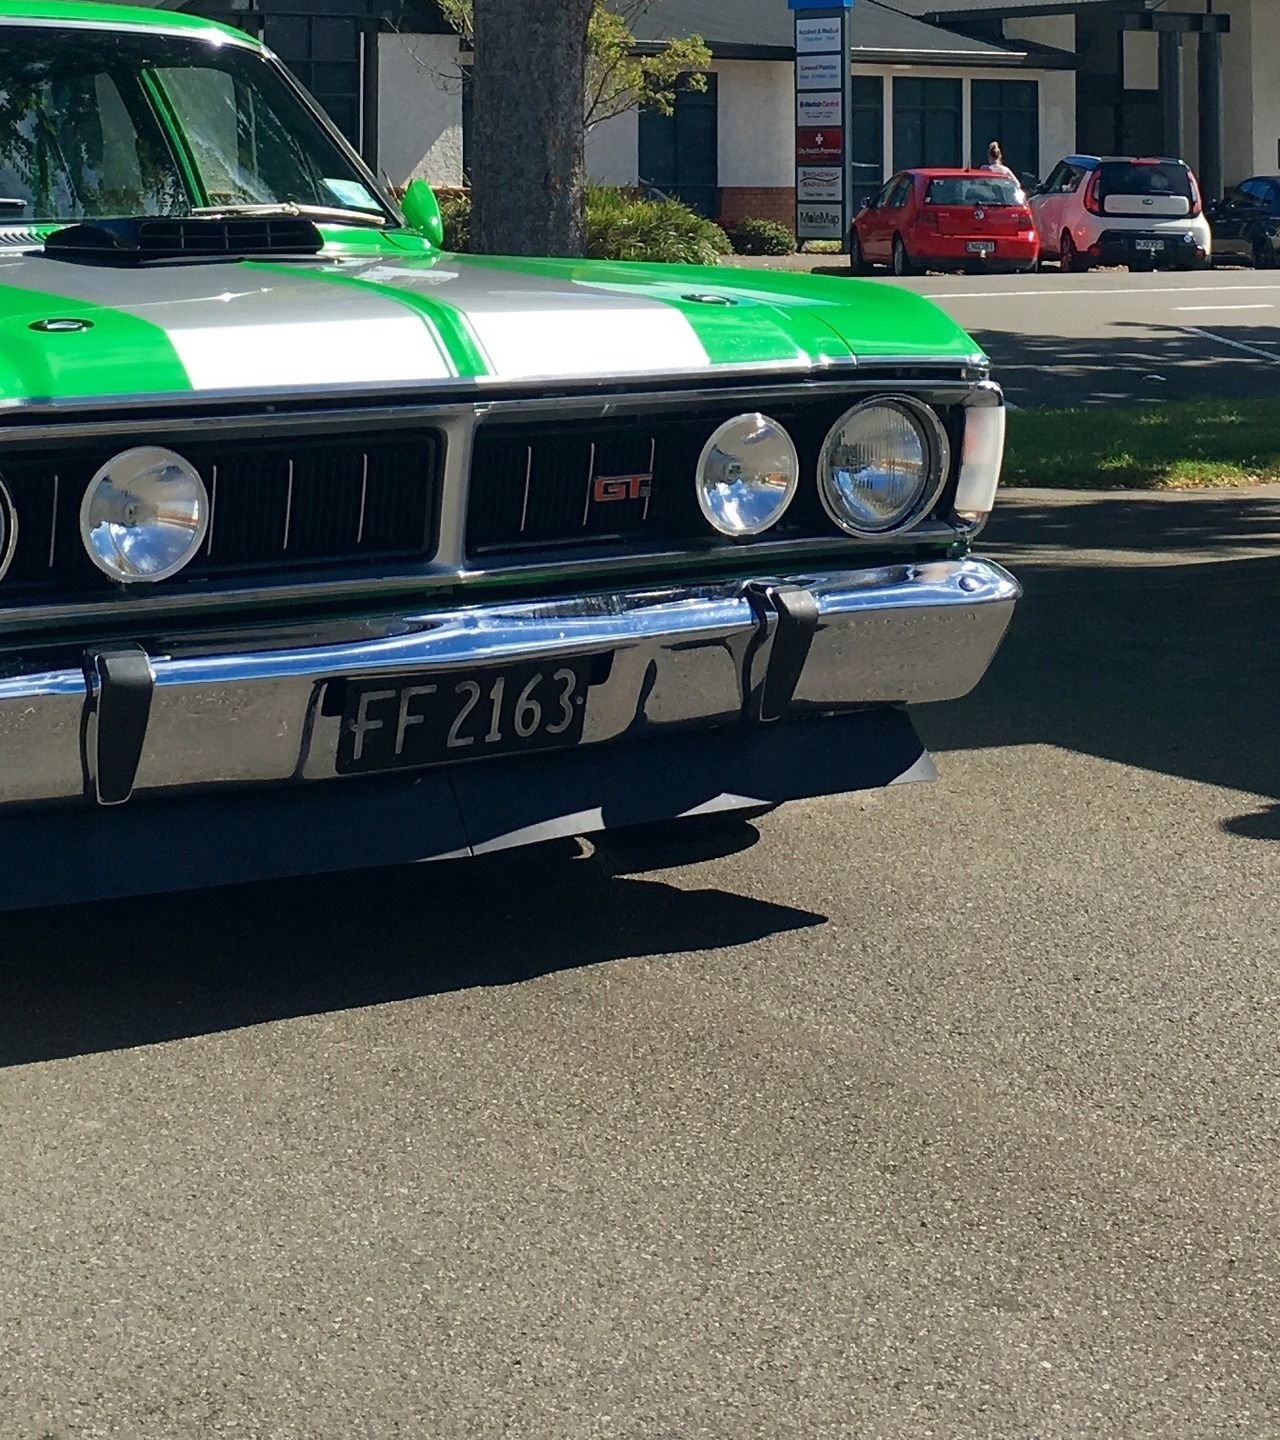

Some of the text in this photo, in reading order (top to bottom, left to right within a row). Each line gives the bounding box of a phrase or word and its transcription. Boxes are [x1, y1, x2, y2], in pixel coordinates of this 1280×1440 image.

[593, 473, 653, 503] GT
[352, 668, 577, 760] FF 2163
